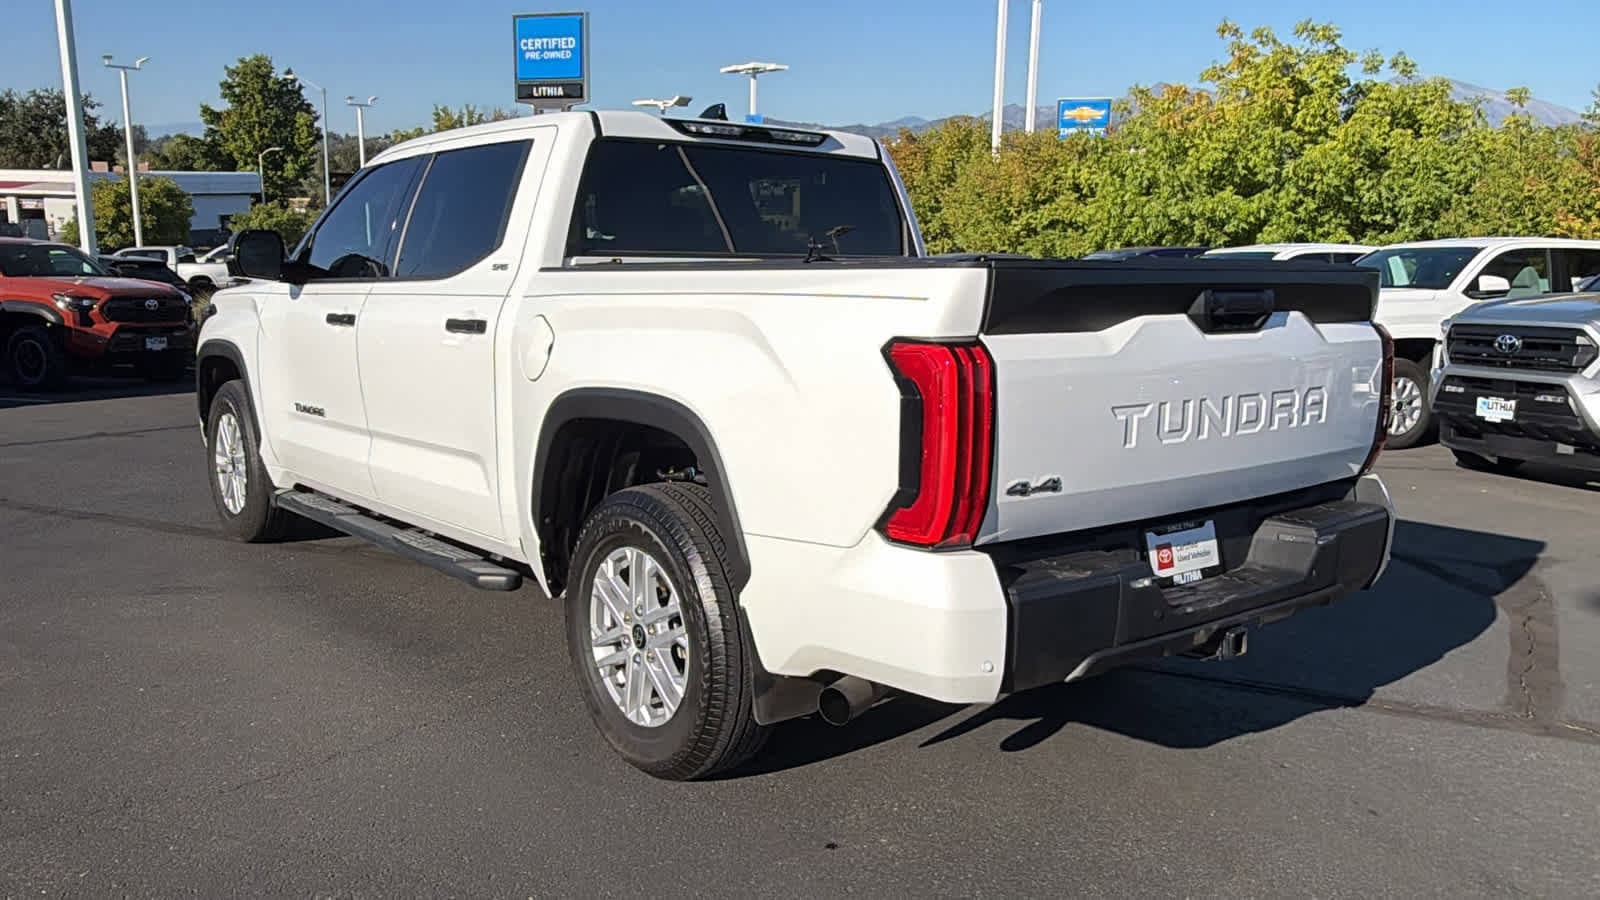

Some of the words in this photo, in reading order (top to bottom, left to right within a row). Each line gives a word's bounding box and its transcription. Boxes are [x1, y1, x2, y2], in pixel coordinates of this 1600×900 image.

[520, 37, 576, 50] CERTIFIED
[525, 50, 572, 60] PRE-OWNED
[532, 86, 564, 97] LITHIA
[294, 402, 326, 417] TUNDRA
[1487, 400, 1513, 411] LITHIA
[1111, 385, 1328, 449] TUNDRA
[1177, 552, 1190, 561] Used
[1179, 570, 1202, 584] LITHIA
